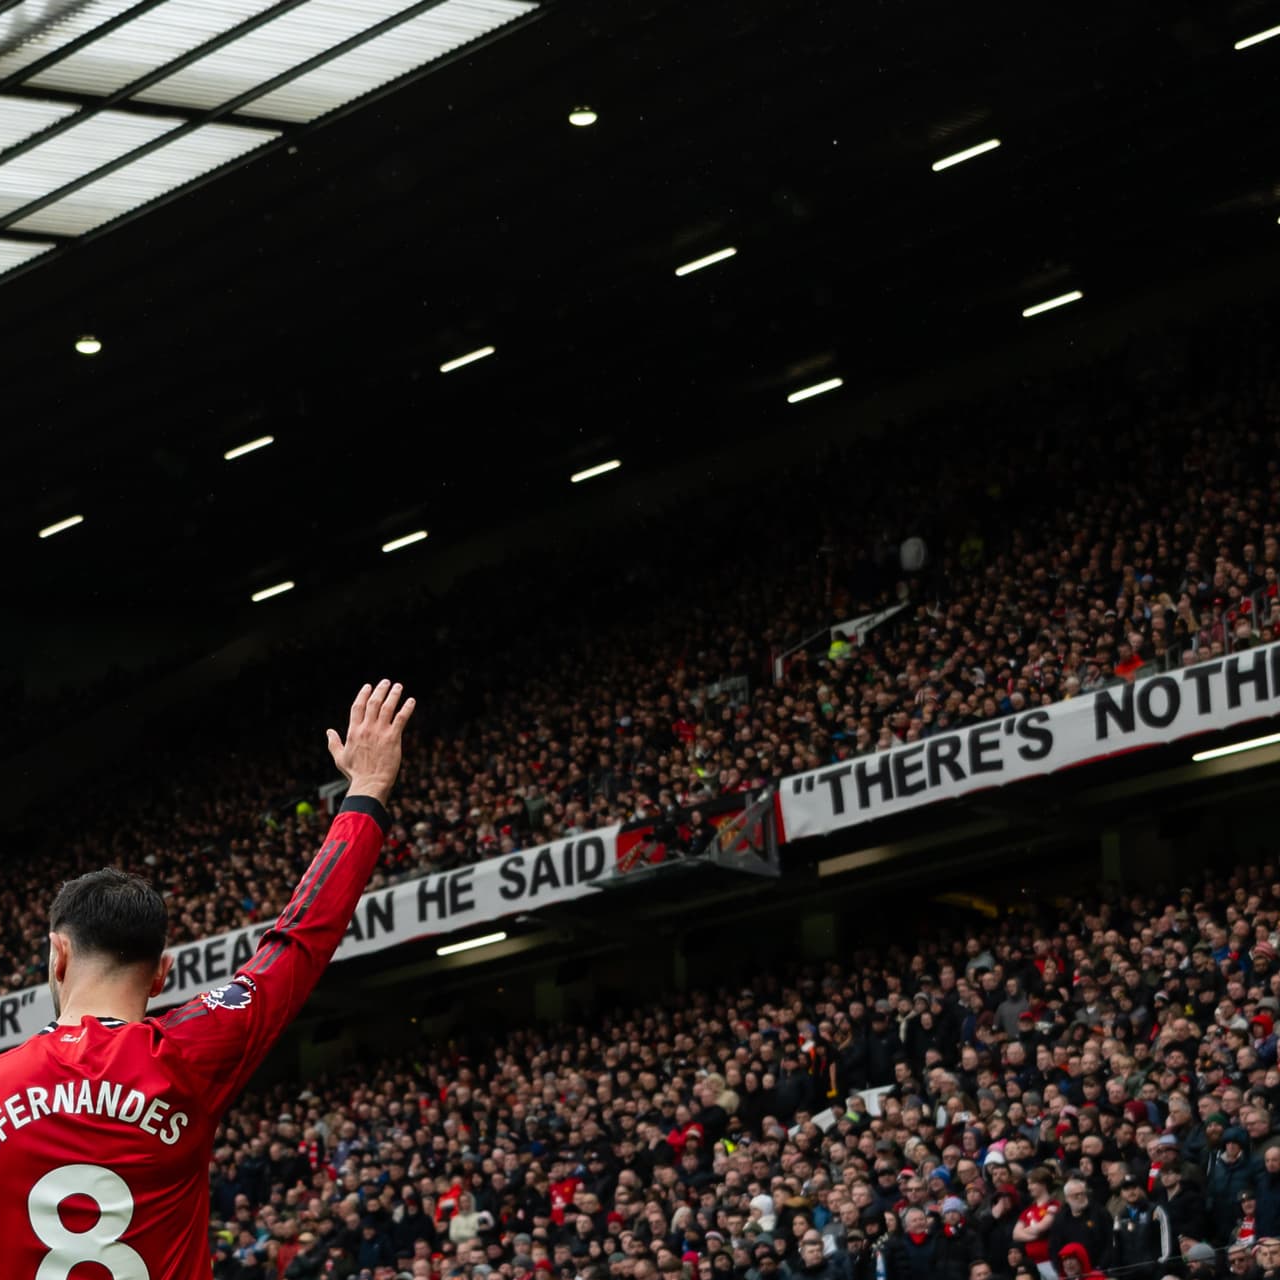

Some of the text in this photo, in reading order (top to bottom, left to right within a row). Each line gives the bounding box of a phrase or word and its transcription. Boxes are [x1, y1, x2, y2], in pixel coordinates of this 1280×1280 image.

[792, 710, 1054, 816] "THERE'S
[160, 918, 272, 993] REA
[338, 890, 395, 943] AN
[416, 867, 476, 923] HE
[498, 836, 605, 901] SAID
